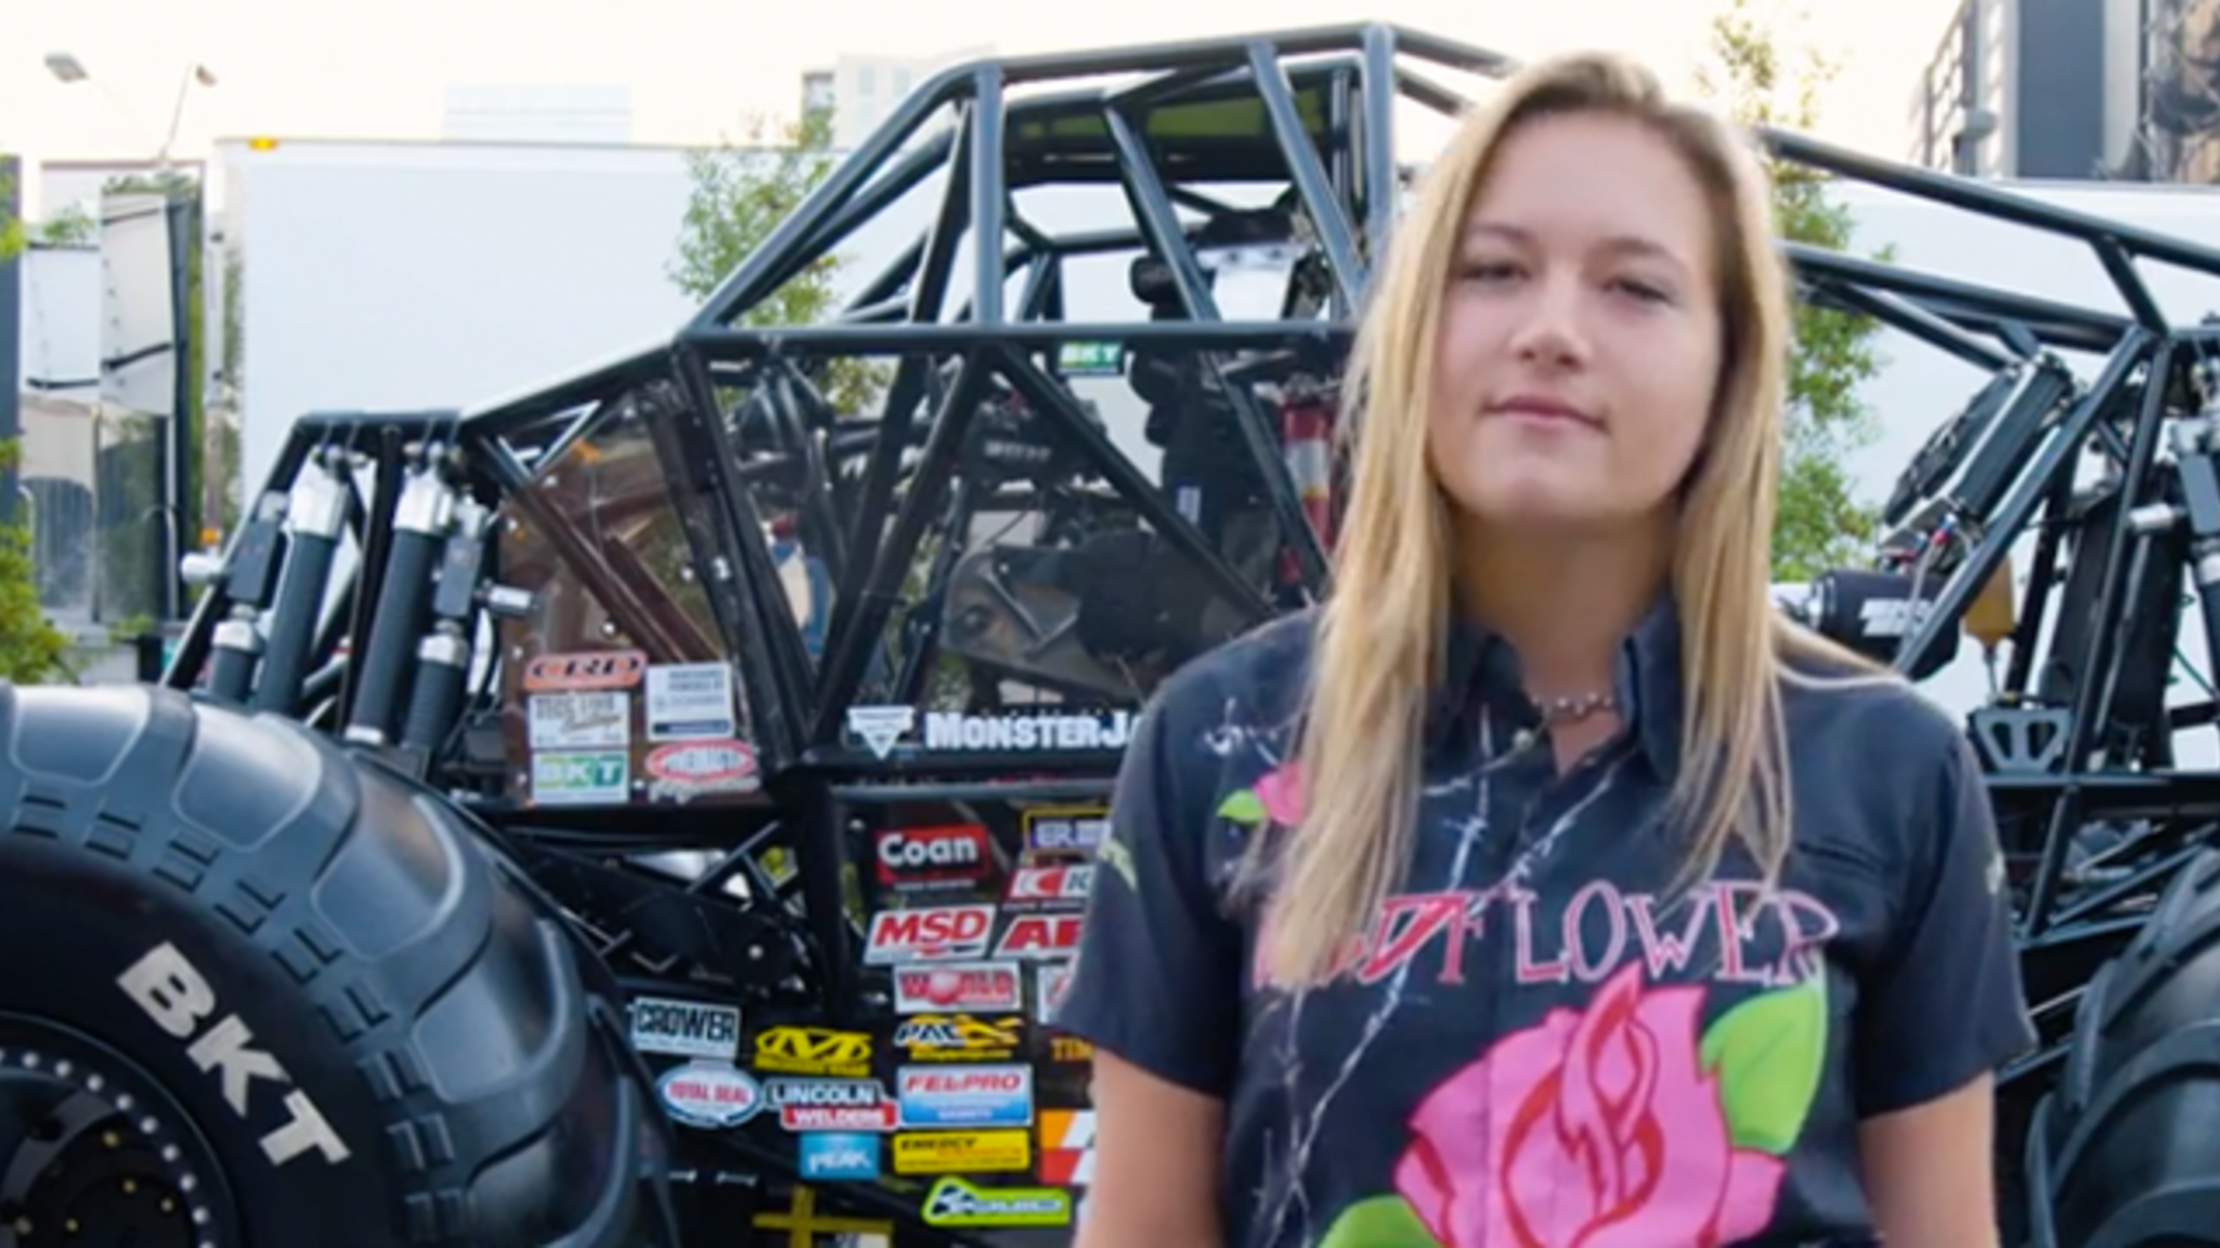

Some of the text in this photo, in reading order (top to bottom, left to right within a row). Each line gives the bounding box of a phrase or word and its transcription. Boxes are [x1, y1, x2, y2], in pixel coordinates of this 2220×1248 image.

[535, 754, 626, 788] BKT
[878, 834, 978, 867] Coan
[875, 907, 987, 947] MSD
[901, 969, 1014, 1004] WORLD
[635, 1003, 737, 1043] CROWER
[115, 940, 351, 1166] BKT
[667, 1081, 749, 1105] TOTAL SEAL
[770, 1081, 874, 1106] LINCOLN
[792, 1106, 880, 1127] WELDERS
[807, 1152, 872, 1173] PEAK
